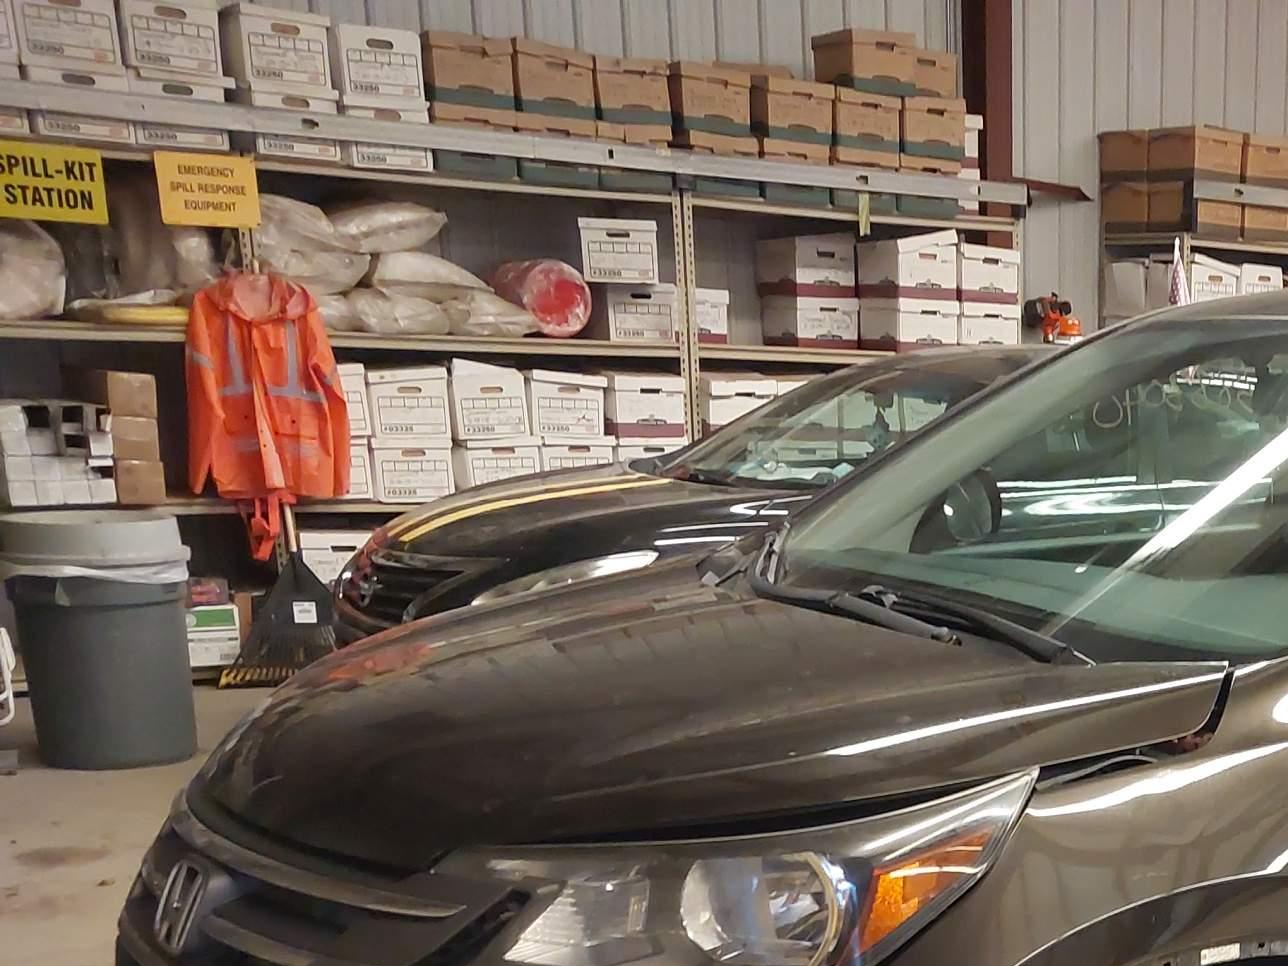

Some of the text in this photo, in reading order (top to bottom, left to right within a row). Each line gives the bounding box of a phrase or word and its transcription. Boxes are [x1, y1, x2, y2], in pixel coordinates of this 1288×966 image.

[177, 164, 235, 178] EMERGENCY
[169, 181, 247, 196] SPILL RESPONSE
[4, 183, 95, 211] STATION
[184, 199, 237, 212] EQUIPMENT
